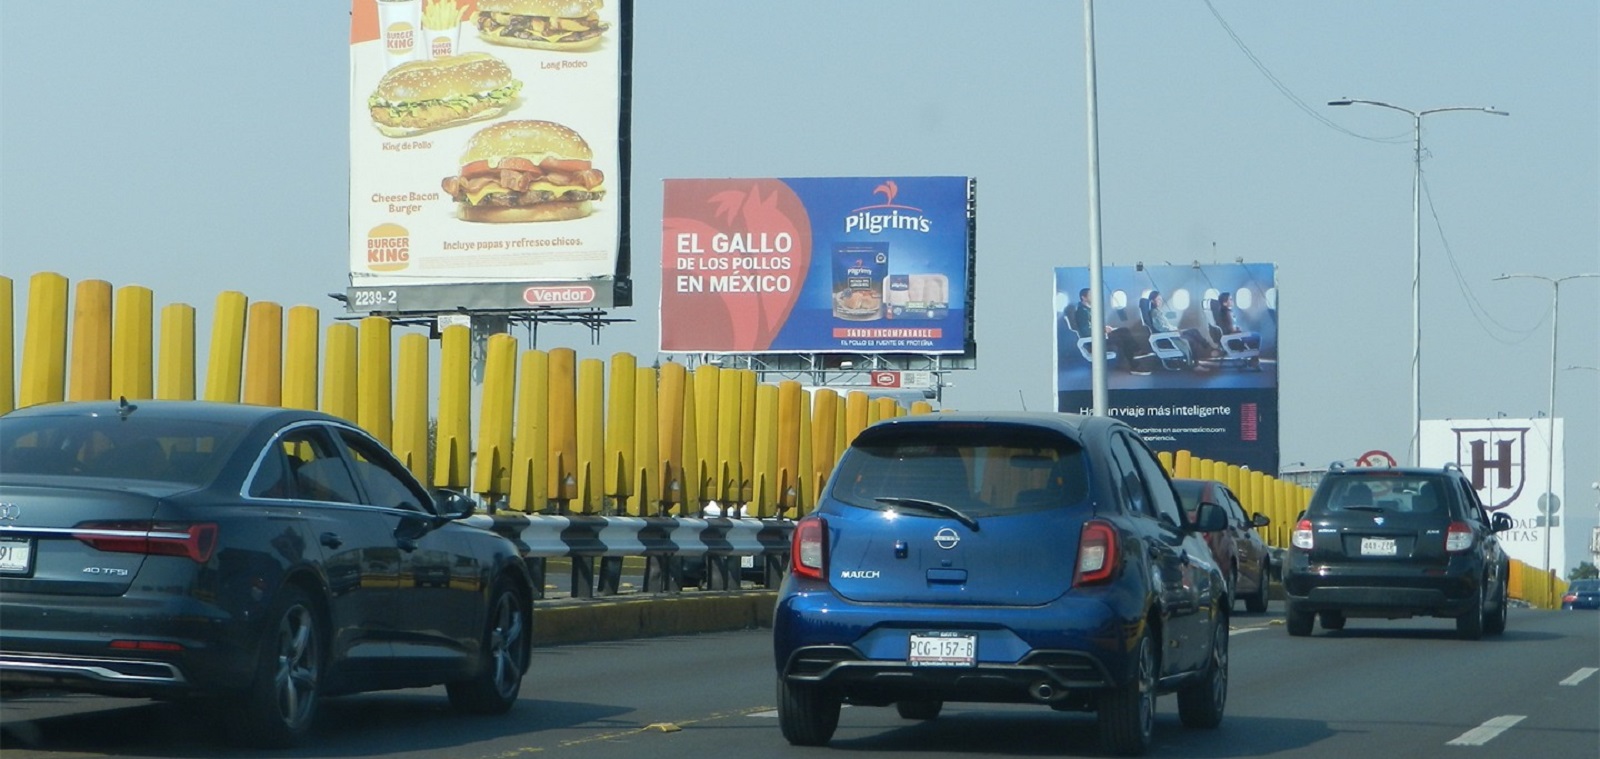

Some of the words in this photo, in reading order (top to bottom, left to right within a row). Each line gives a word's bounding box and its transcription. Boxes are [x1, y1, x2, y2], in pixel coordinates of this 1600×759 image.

[387, 31, 414, 39] BURGER
[387, 39, 414, 48] KING
[540, 61, 560, 71] Long
[562, 60, 588, 68] Rodeo
[382, 142, 400, 151] King
[401, 142, 412, 150] de
[413, 141, 432, 149] Pollo
[371, 193, 408, 202] Cheese
[409, 192, 439, 201] Bacon
[389, 203, 422, 215] Burger
[845, 210, 930, 234] Pilgrim's
[367, 238, 409, 249] BURGER
[443, 240, 475, 251] Incluye
[477, 240, 503, 250] papas
[504, 241, 512, 250] y
[512, 238, 550, 248] refresco
[551, 237, 584, 247] chicos.
[677, 233, 704, 253] EL
[712, 232, 792, 253] GALLO
[367, 248, 409, 263] KING
[677, 257, 695, 270] DE
[699, 257, 729, 270] LOS
[732, 257, 791, 270] POLLOS
[677, 275, 703, 293] EN
[710, 270, 791, 293] MÉXICO
[355, 290, 397, 306] 2239-2
[533, 289, 588, 301] Vendor
[847, 329, 871, 337] SABOR
[873, 329, 932, 338] INCOMPARABLE
[1120, 405, 1145, 418] viaje
[1147, 405, 1171, 416] más
[1172, 405, 1231, 418] inteligente
[1469, 438, 1517, 491] H
[102, 567, 128, 576] TFSI
[841, 570, 880, 579] MARCH
[910, 640, 973, 657] PCG-157-B
